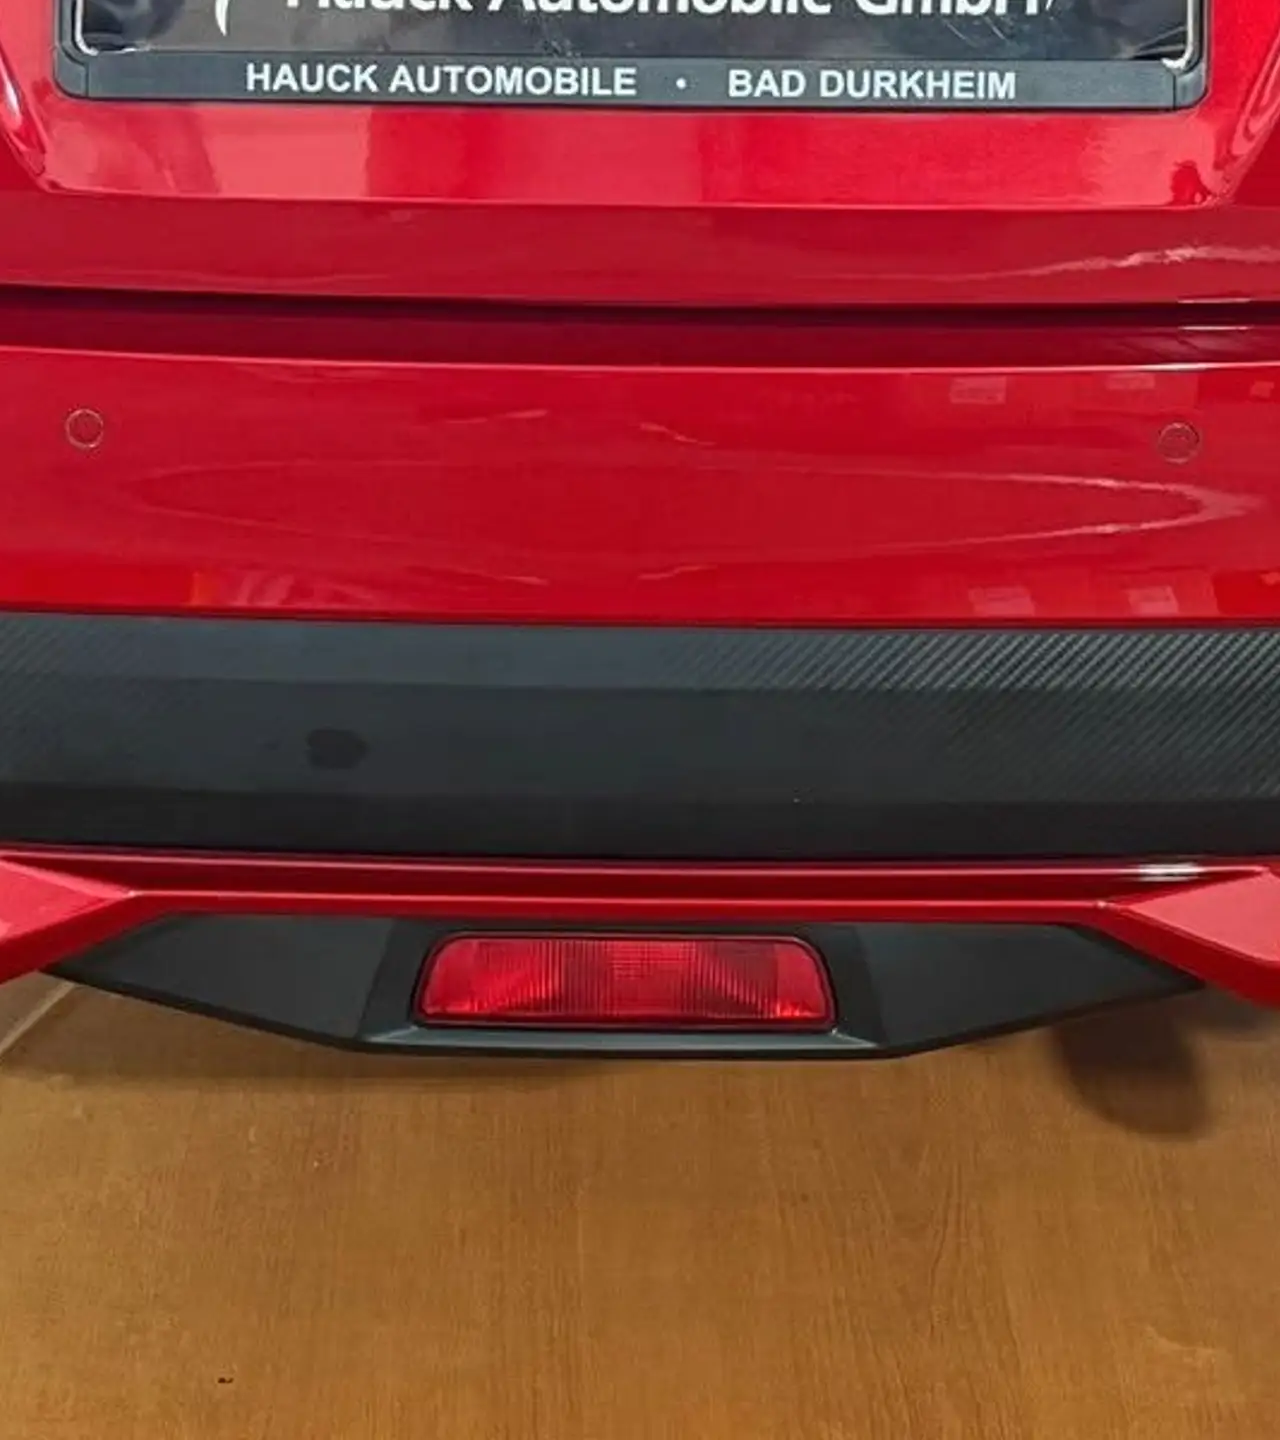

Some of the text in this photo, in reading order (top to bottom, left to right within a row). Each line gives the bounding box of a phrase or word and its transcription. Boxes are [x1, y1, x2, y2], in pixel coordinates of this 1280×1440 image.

[246, 63, 1017, 100] HAUCK AUTOMOBILE BAD DURKHEIM
